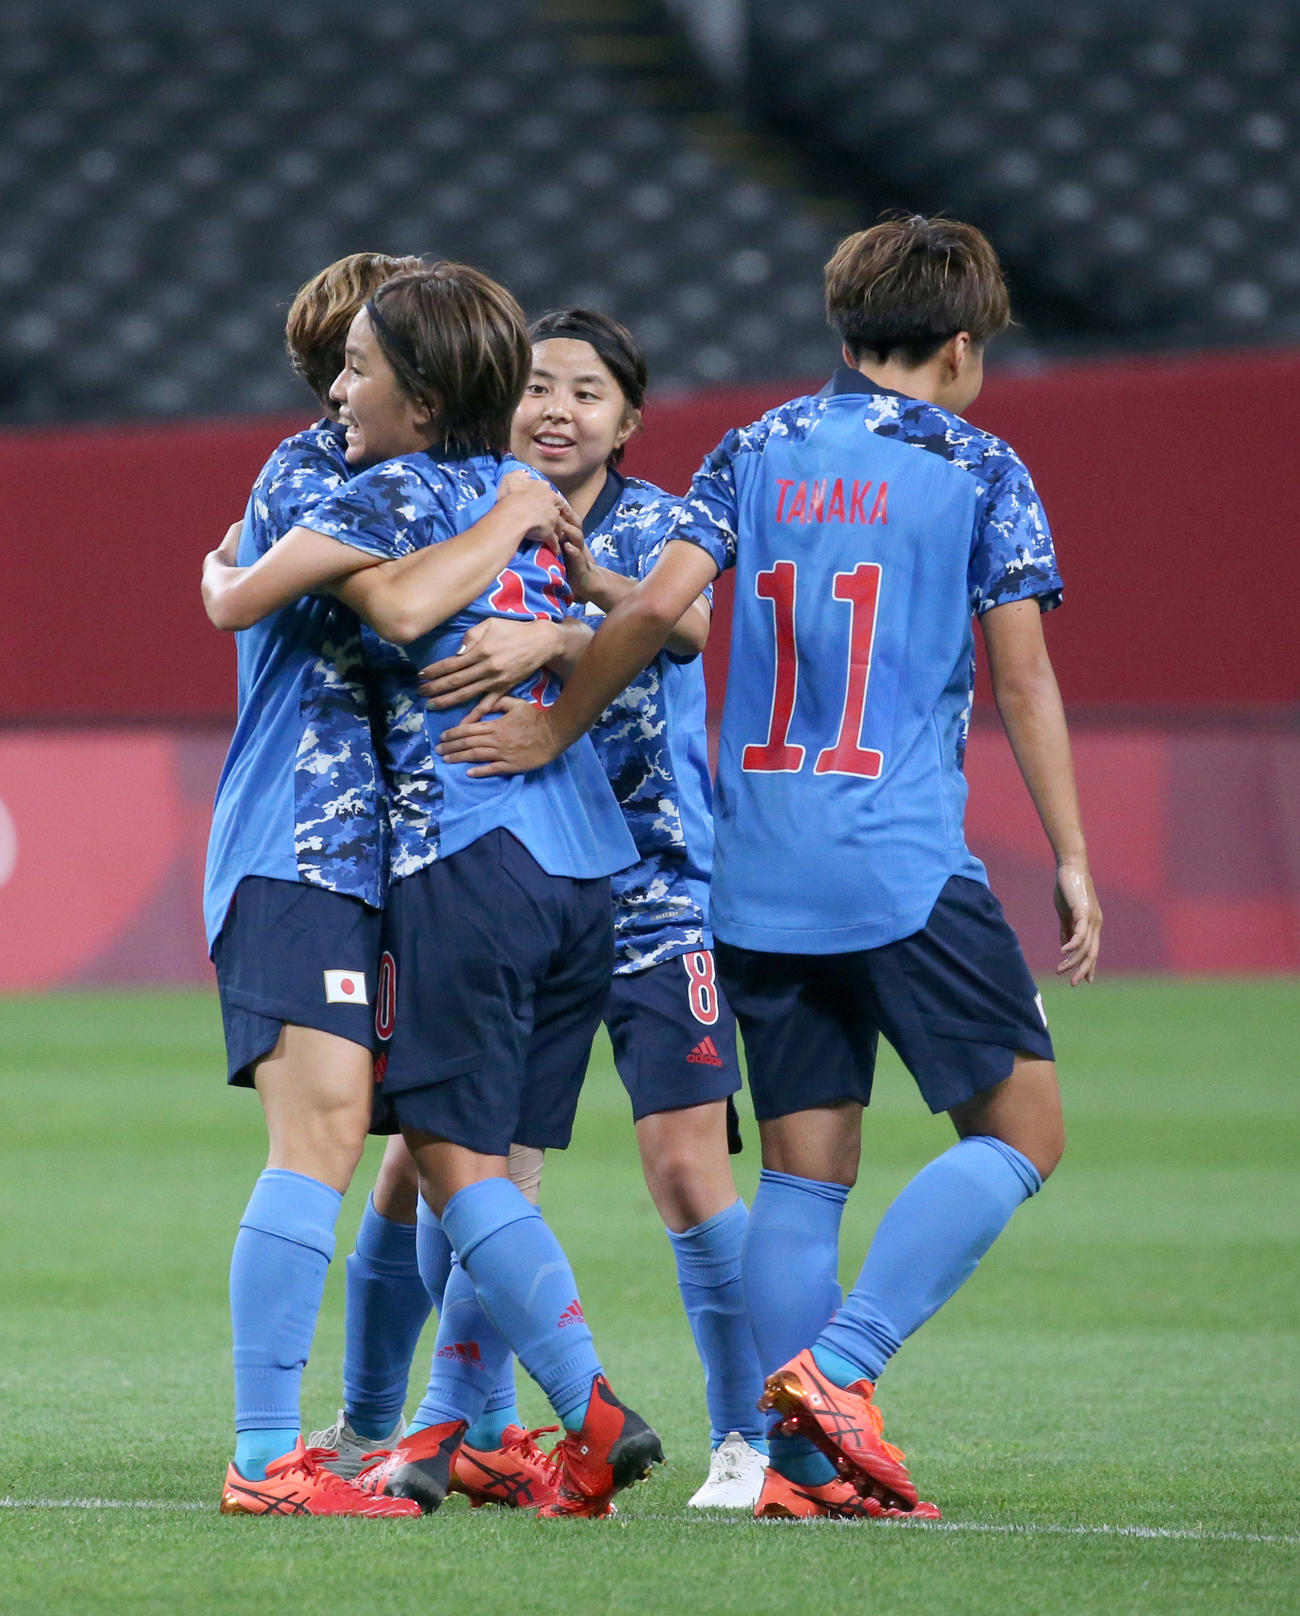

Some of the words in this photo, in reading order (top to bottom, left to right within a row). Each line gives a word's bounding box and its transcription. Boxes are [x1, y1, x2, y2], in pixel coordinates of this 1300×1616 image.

[776, 478, 888, 525] TANAKA
[741, 559, 883, 779] 11
[682, 950, 719, 1025] 8
[686, 1053, 722, 1067] adidas
